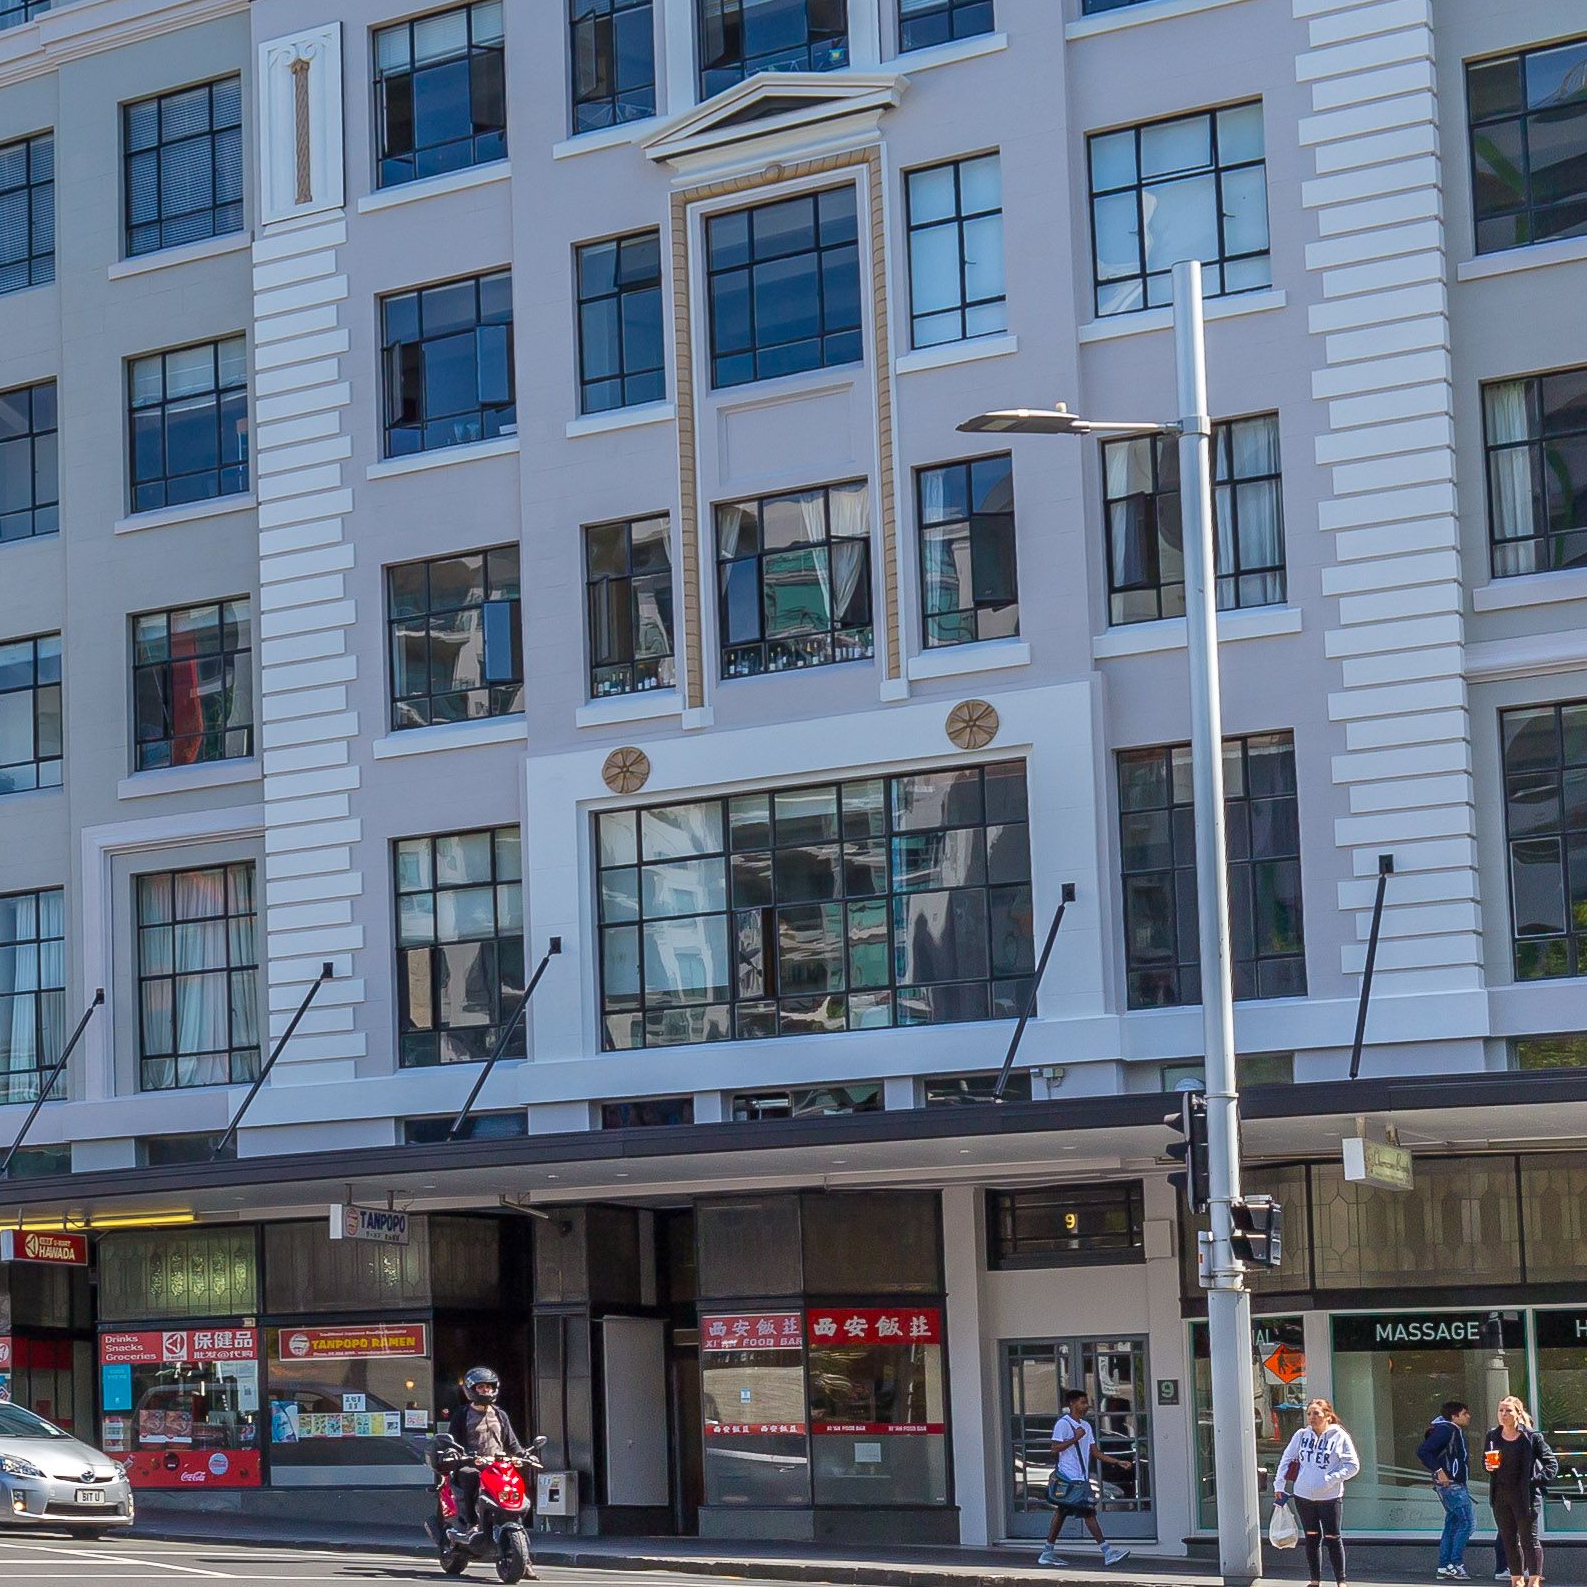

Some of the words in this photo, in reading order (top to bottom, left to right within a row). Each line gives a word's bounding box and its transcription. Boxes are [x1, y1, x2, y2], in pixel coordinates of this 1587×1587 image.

[360, 1211, 405, 1233] TANPOPO
[1065, 1213, 1076, 1229] 9
[1376, 1322, 1481, 1342] MASSAGE
[105, 1335, 138, 1343] Drinks
[193, 1331, 253, 1349] 保健品
[311, 1339, 368, 1350] TANPOPO
[371, 1337, 416, 1348] RAMEN
[743, 1338, 774, 1347] FOOD
[780, 1337, 803, 1346] BAR
[105, 1344, 143, 1352] Snacks
[105, 1353, 157, 1361] Groceries
[1299, 1450, 1330, 1464] STER
